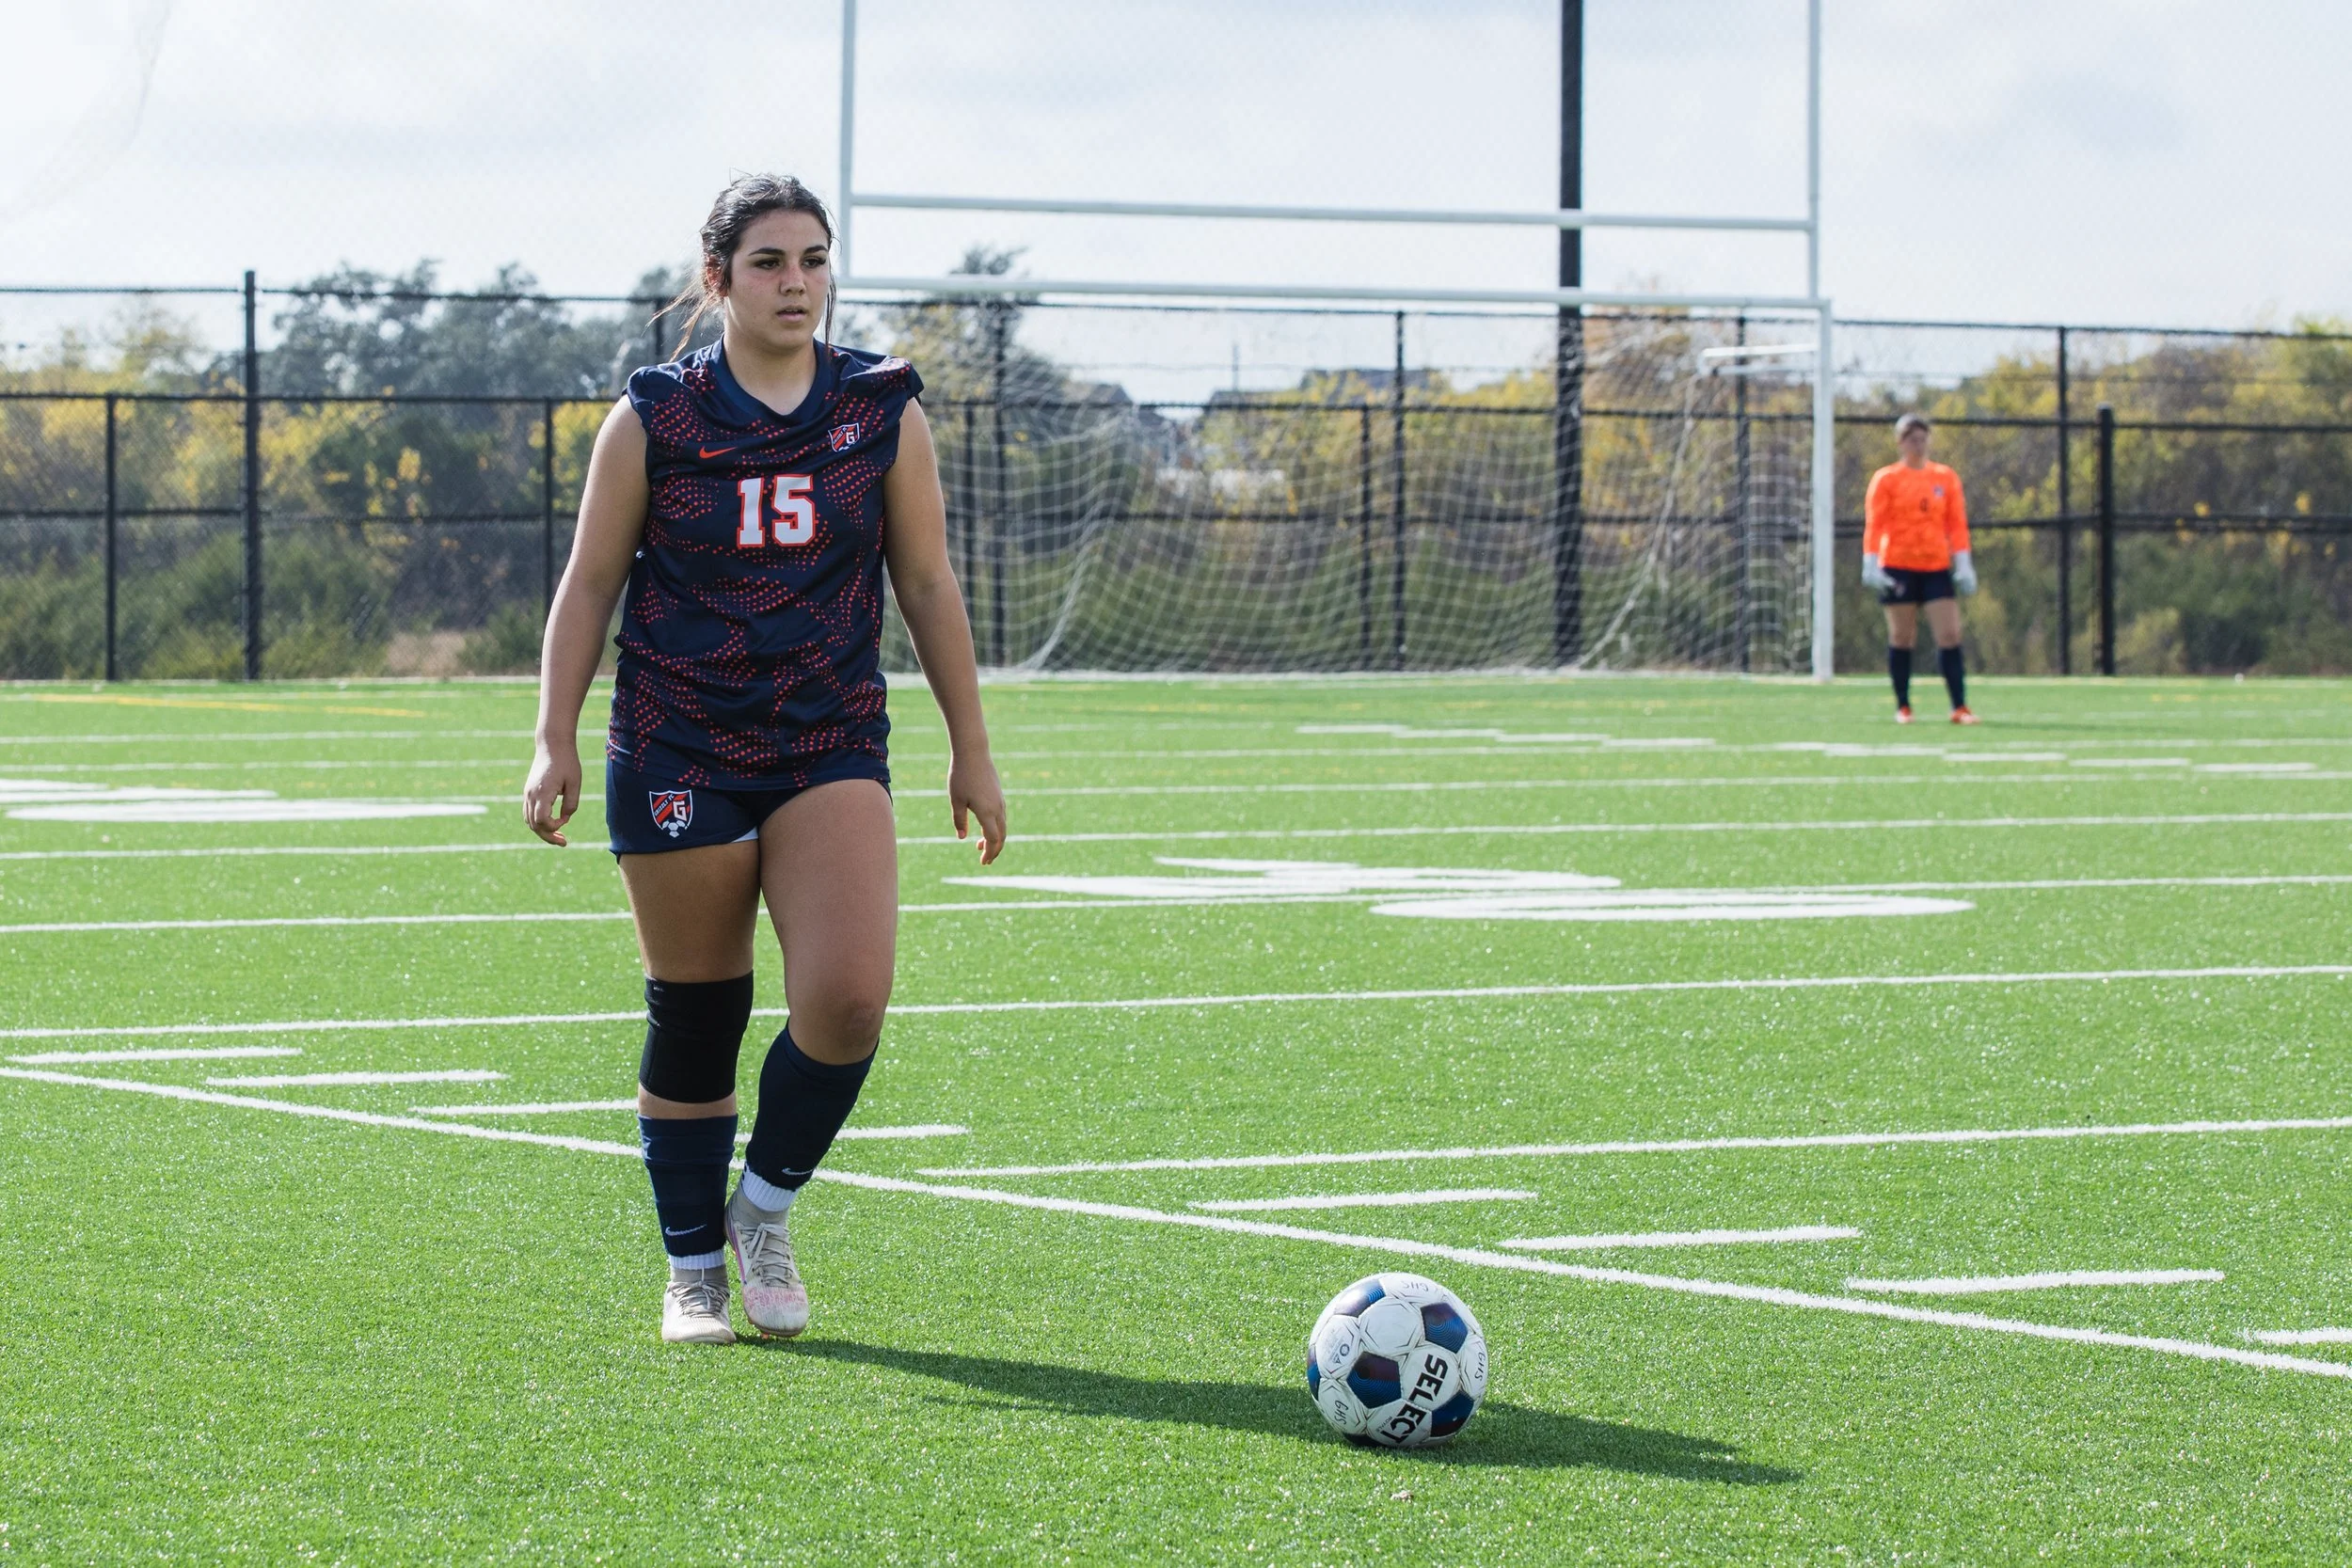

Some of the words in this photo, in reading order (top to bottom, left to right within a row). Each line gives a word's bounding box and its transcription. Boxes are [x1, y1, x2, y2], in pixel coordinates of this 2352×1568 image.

[846, 431, 855, 444] G
[737, 474, 816, 548] 15
[673, 800, 687, 821] G
[1380, 1354, 1449, 1444] SELECT
[1334, 1400, 1349, 1425] GHS
